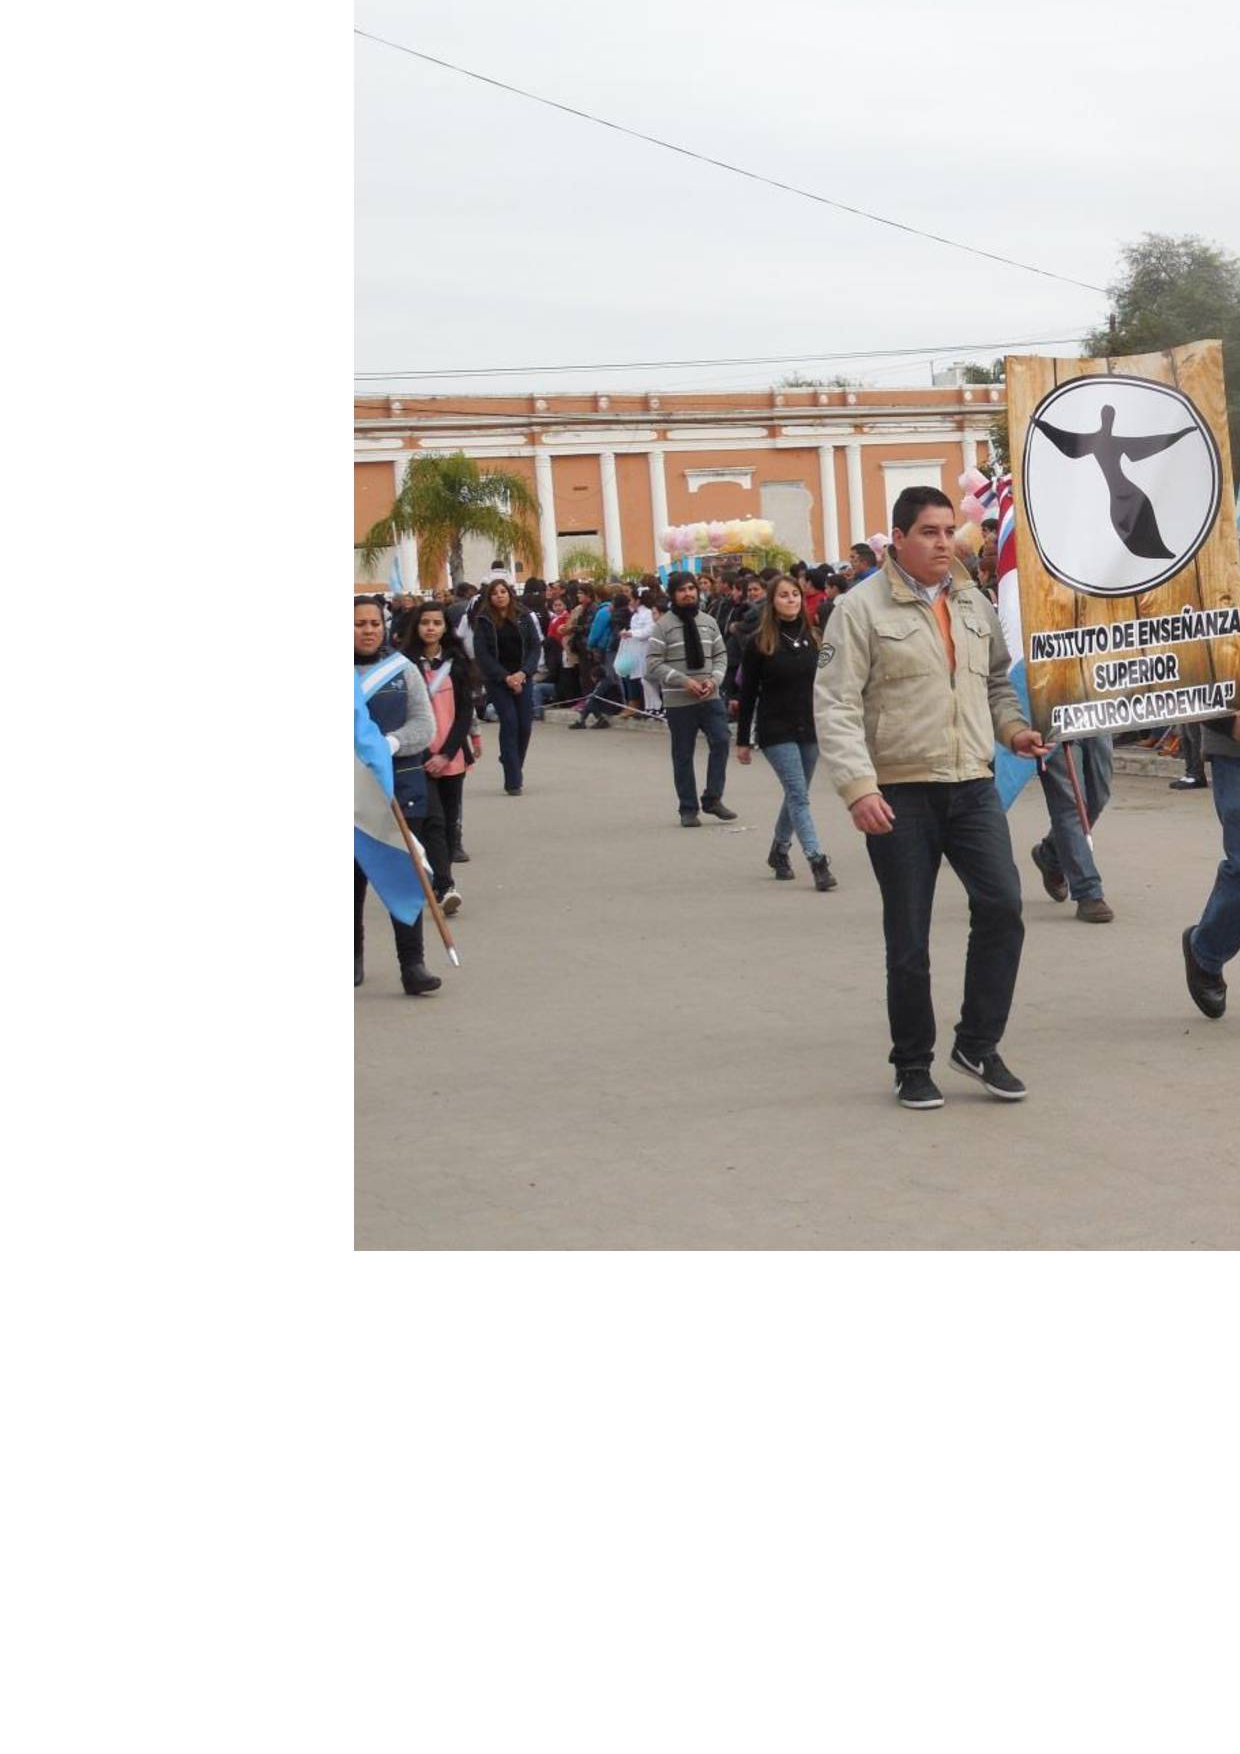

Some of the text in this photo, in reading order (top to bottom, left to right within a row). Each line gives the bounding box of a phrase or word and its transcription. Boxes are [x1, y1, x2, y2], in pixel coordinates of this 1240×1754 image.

[1031, 626, 1108, 660] INSTITUTO
[1112, 623, 1135, 650] DE
[1095, 654, 1177, 689] SUPERIOR
